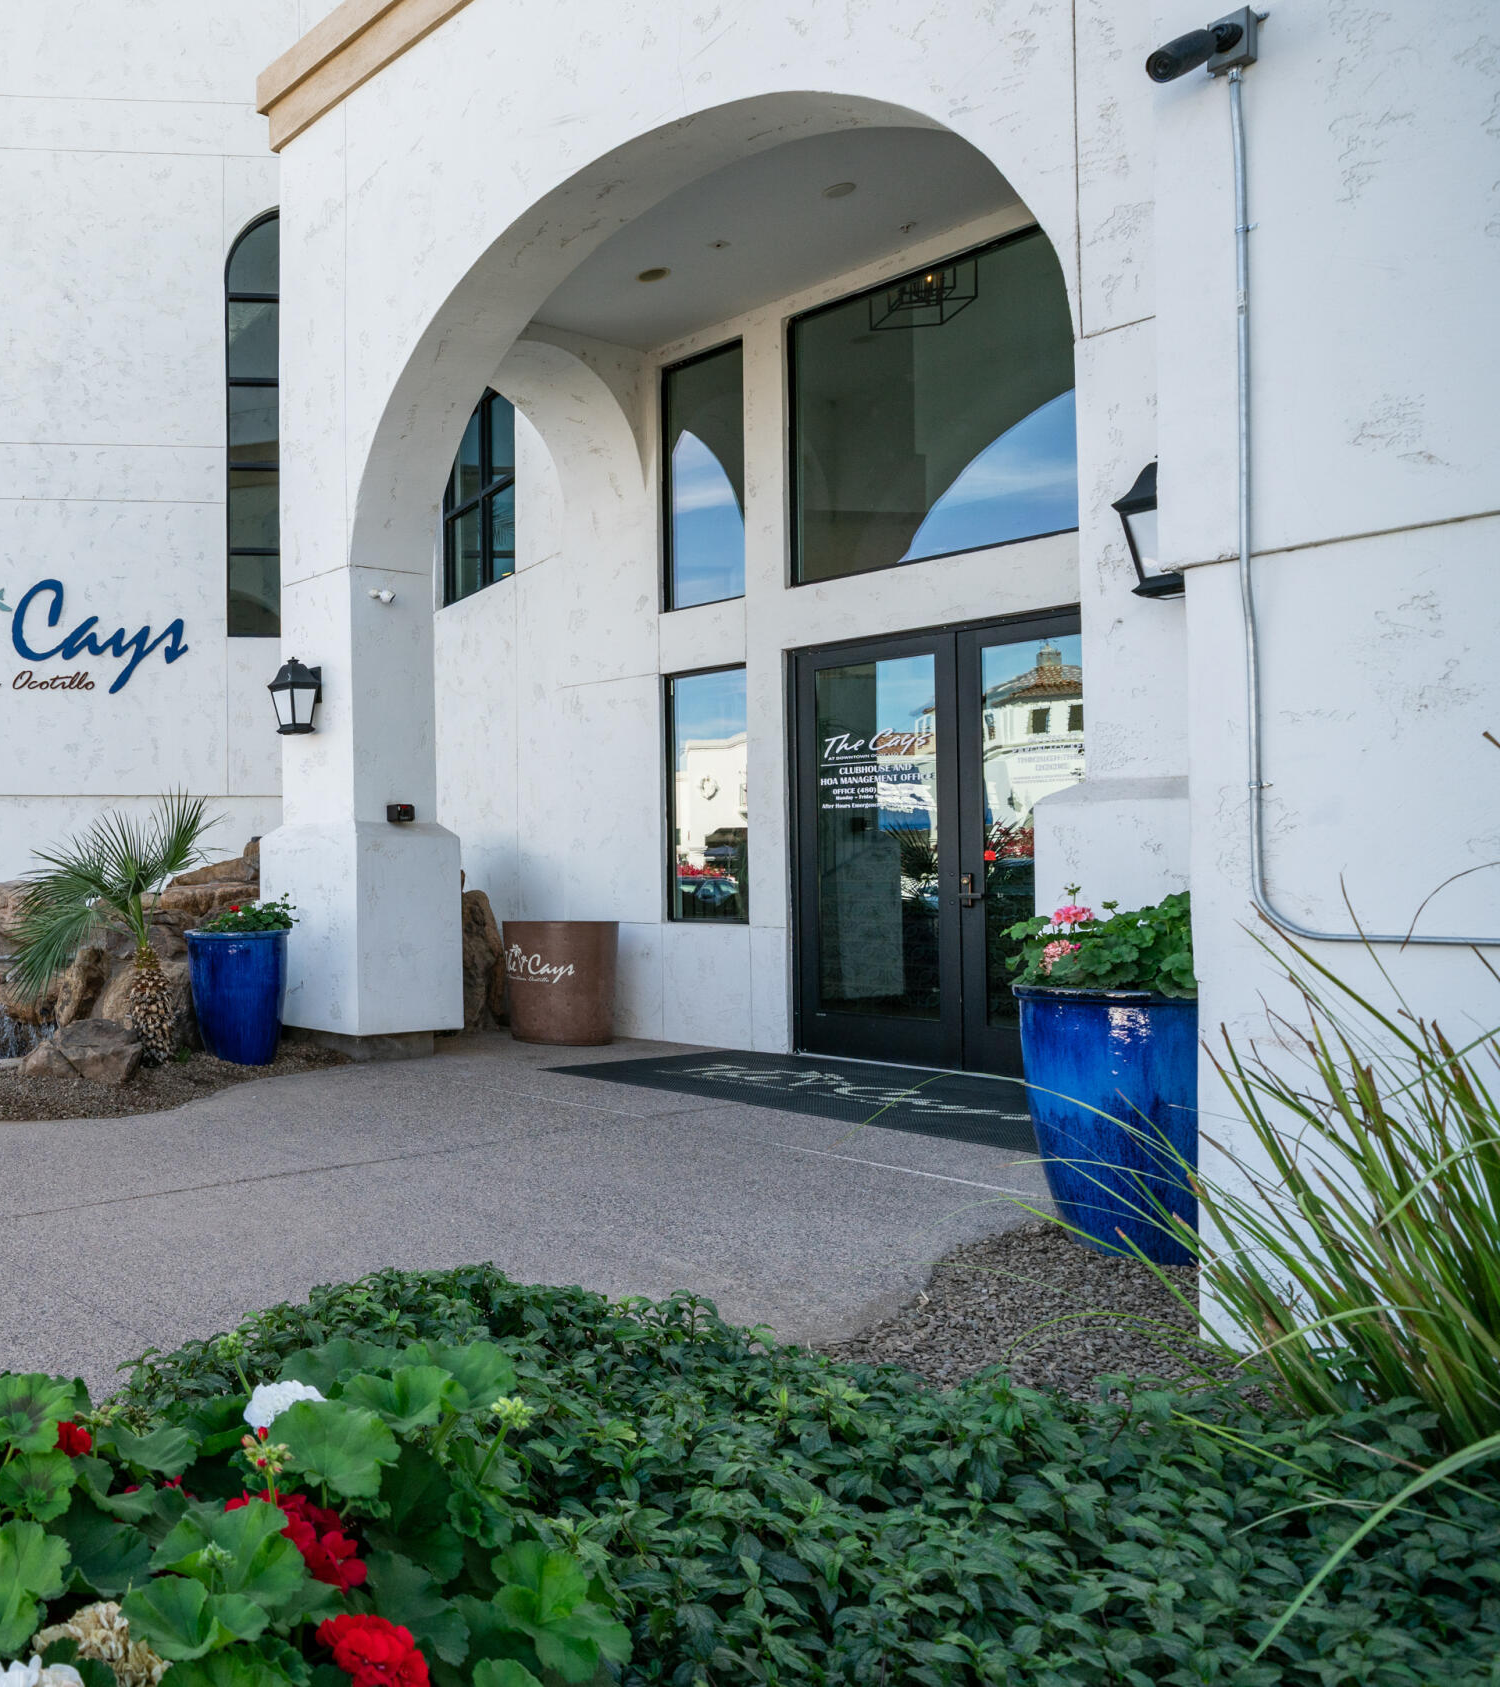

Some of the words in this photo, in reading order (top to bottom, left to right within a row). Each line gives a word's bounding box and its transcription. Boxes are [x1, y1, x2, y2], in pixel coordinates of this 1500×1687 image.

[11, 578, 189, 695] Cays
[11, 669, 96, 691] Ocotillo
[824, 732, 865, 759] The
[868, 727, 934, 755] Cays
[820, 777, 839, 786] HOA
[839, 774, 899, 785] MANAGEMENT
[900, 772, 936, 781] OFFICE
[839, 764, 892, 775] CLUBHOUSE
[893, 763, 913, 772] AND
[832, 787, 855, 795] OFFICE
[527, 953, 575, 984] Cays
